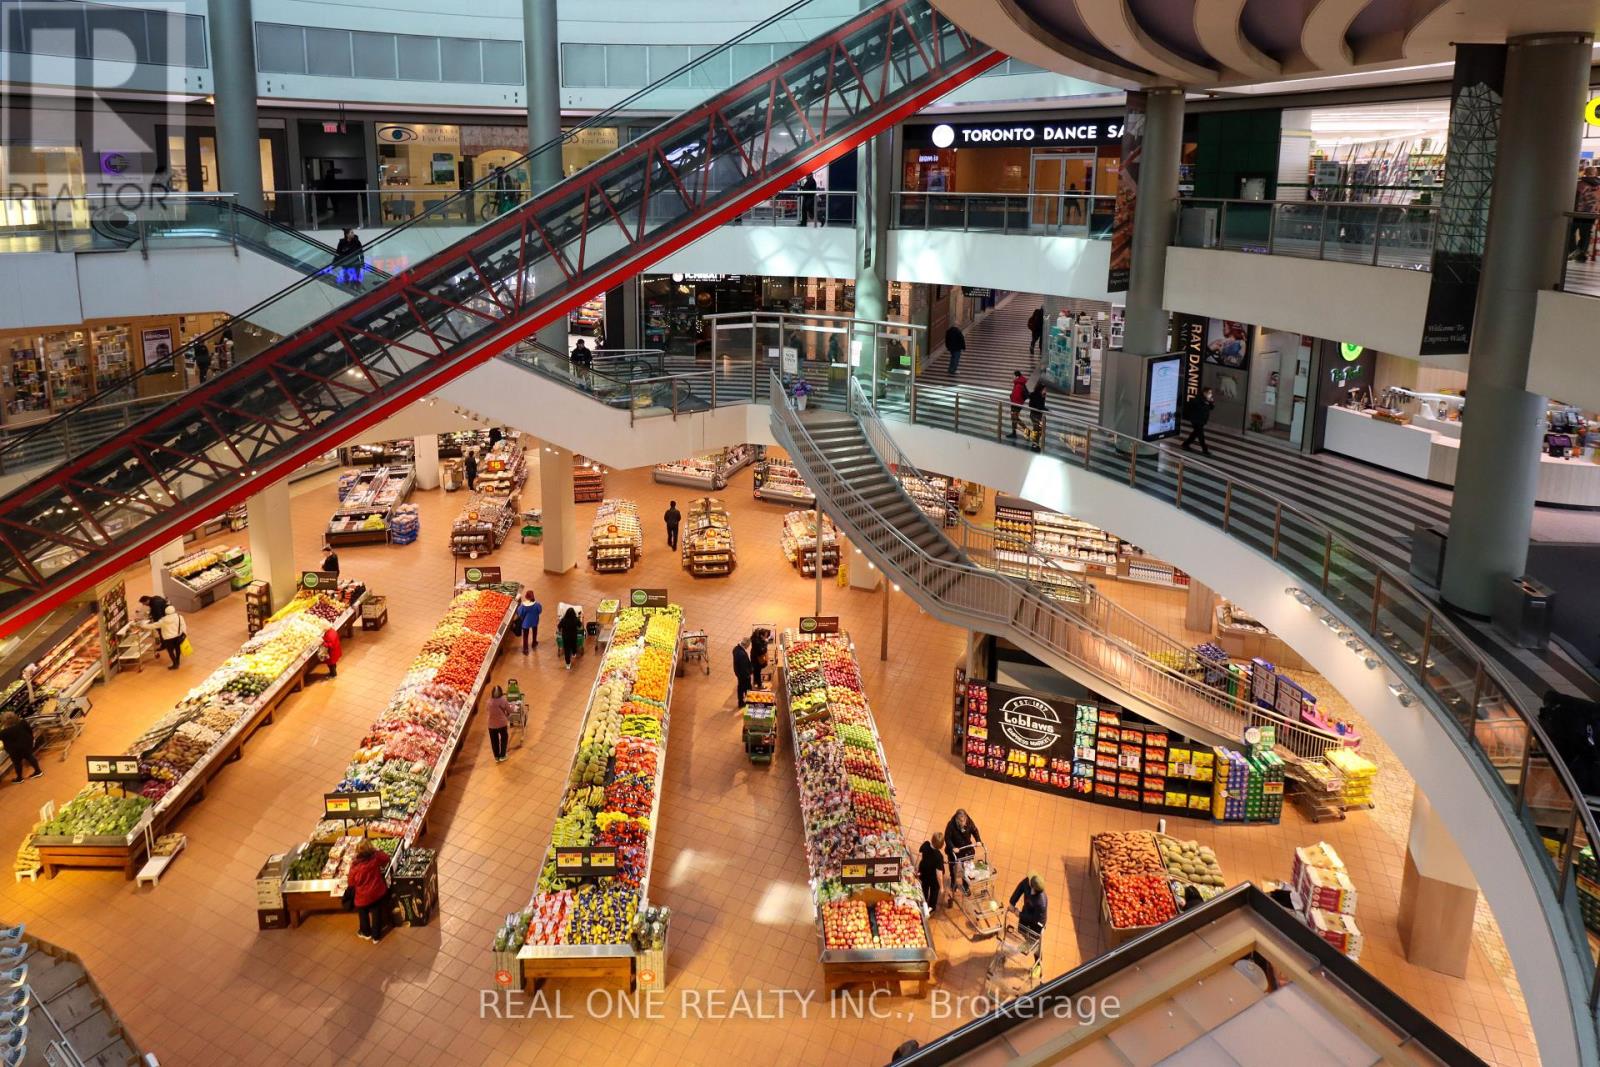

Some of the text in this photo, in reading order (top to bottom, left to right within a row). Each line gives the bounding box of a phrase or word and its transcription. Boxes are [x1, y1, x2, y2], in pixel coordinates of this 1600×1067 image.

[962, 128, 1035, 142] TORONTO
[1043, 125, 1098, 140] DANCE
[1186, 323, 1203, 402] RAY DANIEL
[1004, 711, 1054, 733] Loblaws
[1006, 727, 1052, 746] EMPRESS MARKET
